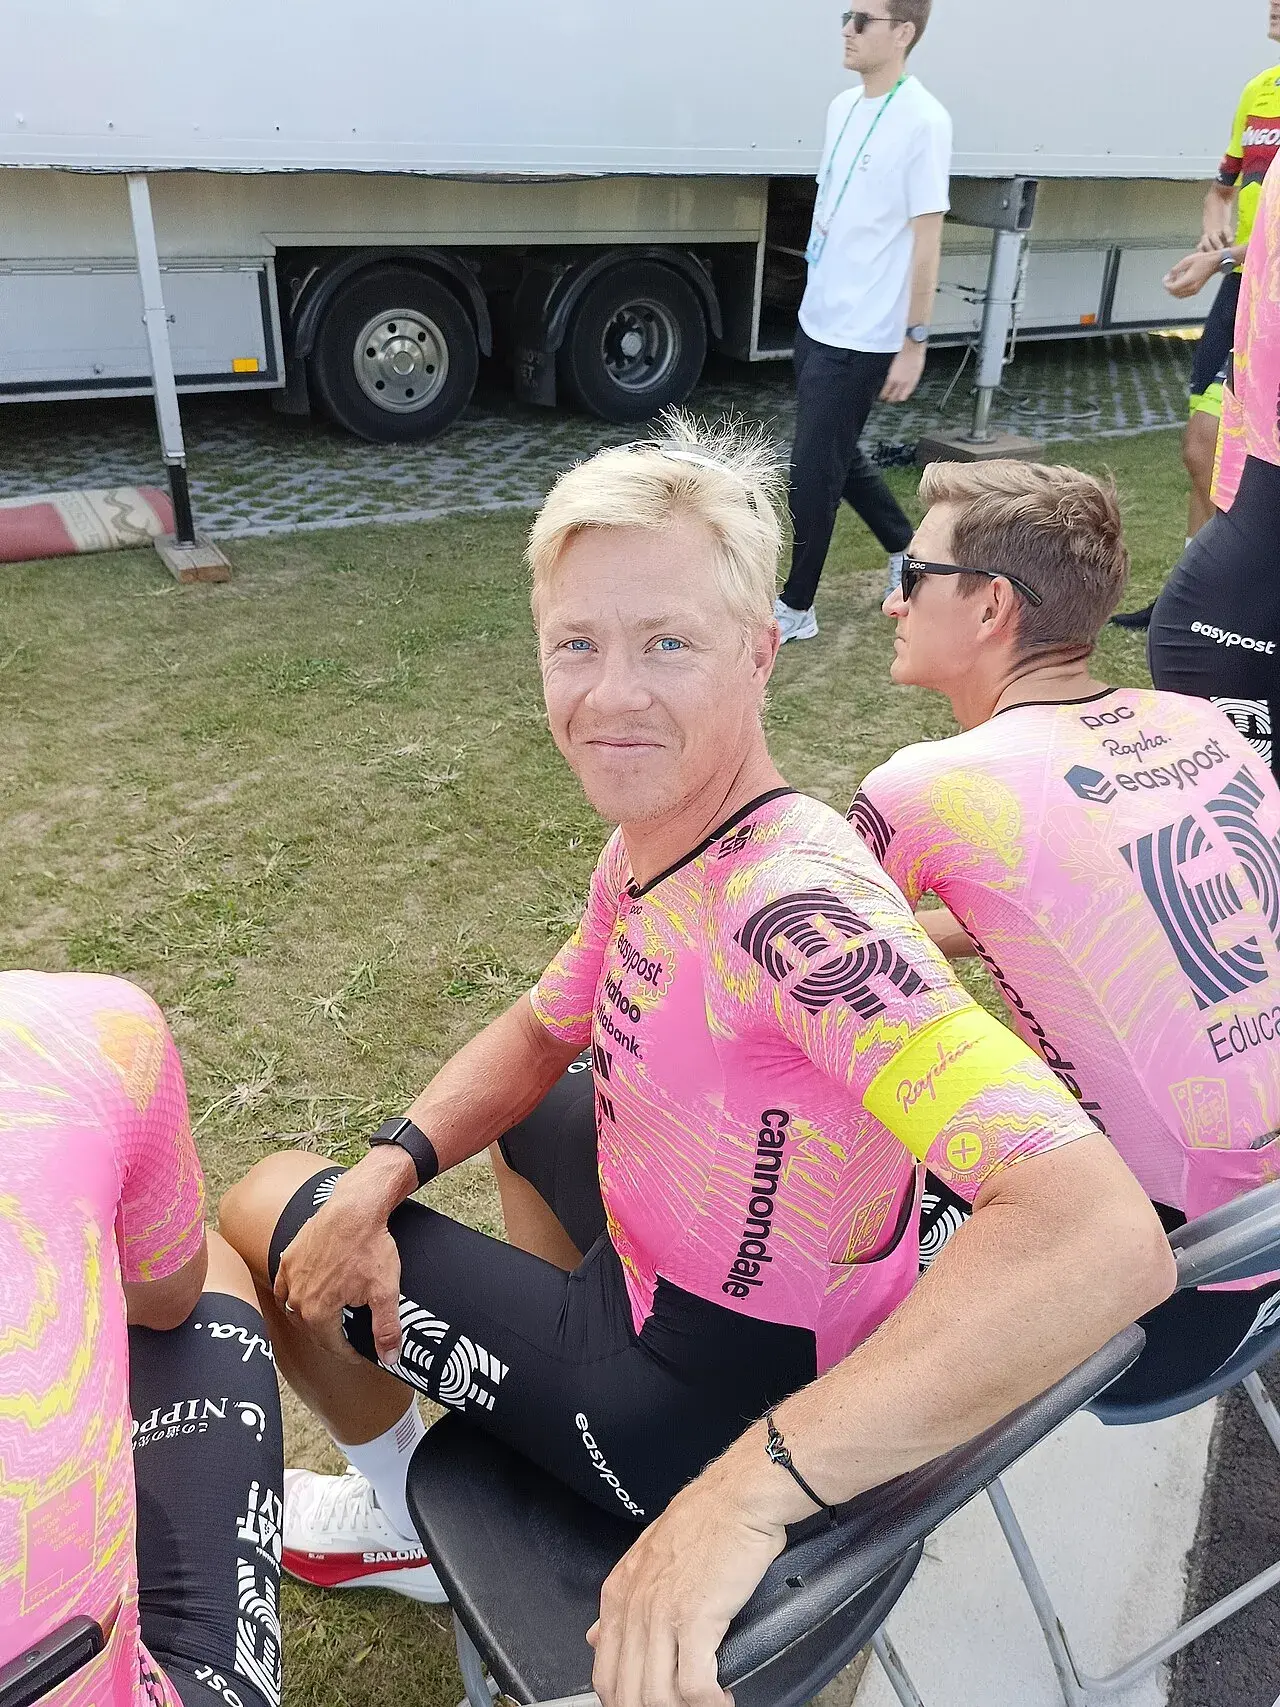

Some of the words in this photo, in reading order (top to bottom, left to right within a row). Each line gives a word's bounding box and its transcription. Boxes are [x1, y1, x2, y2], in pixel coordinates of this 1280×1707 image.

[909, 562, 926, 570] poc
[1190, 621, 1276, 655] easypost
[1079, 706, 1135, 730] poc
[1115, 738, 1230, 792] easypost
[617, 934, 663, 987] easypost
[605, 970, 641, 1024] wahoo
[722, 1108, 790, 1300] cannondale
[575, 1412, 645, 1516] easypost
